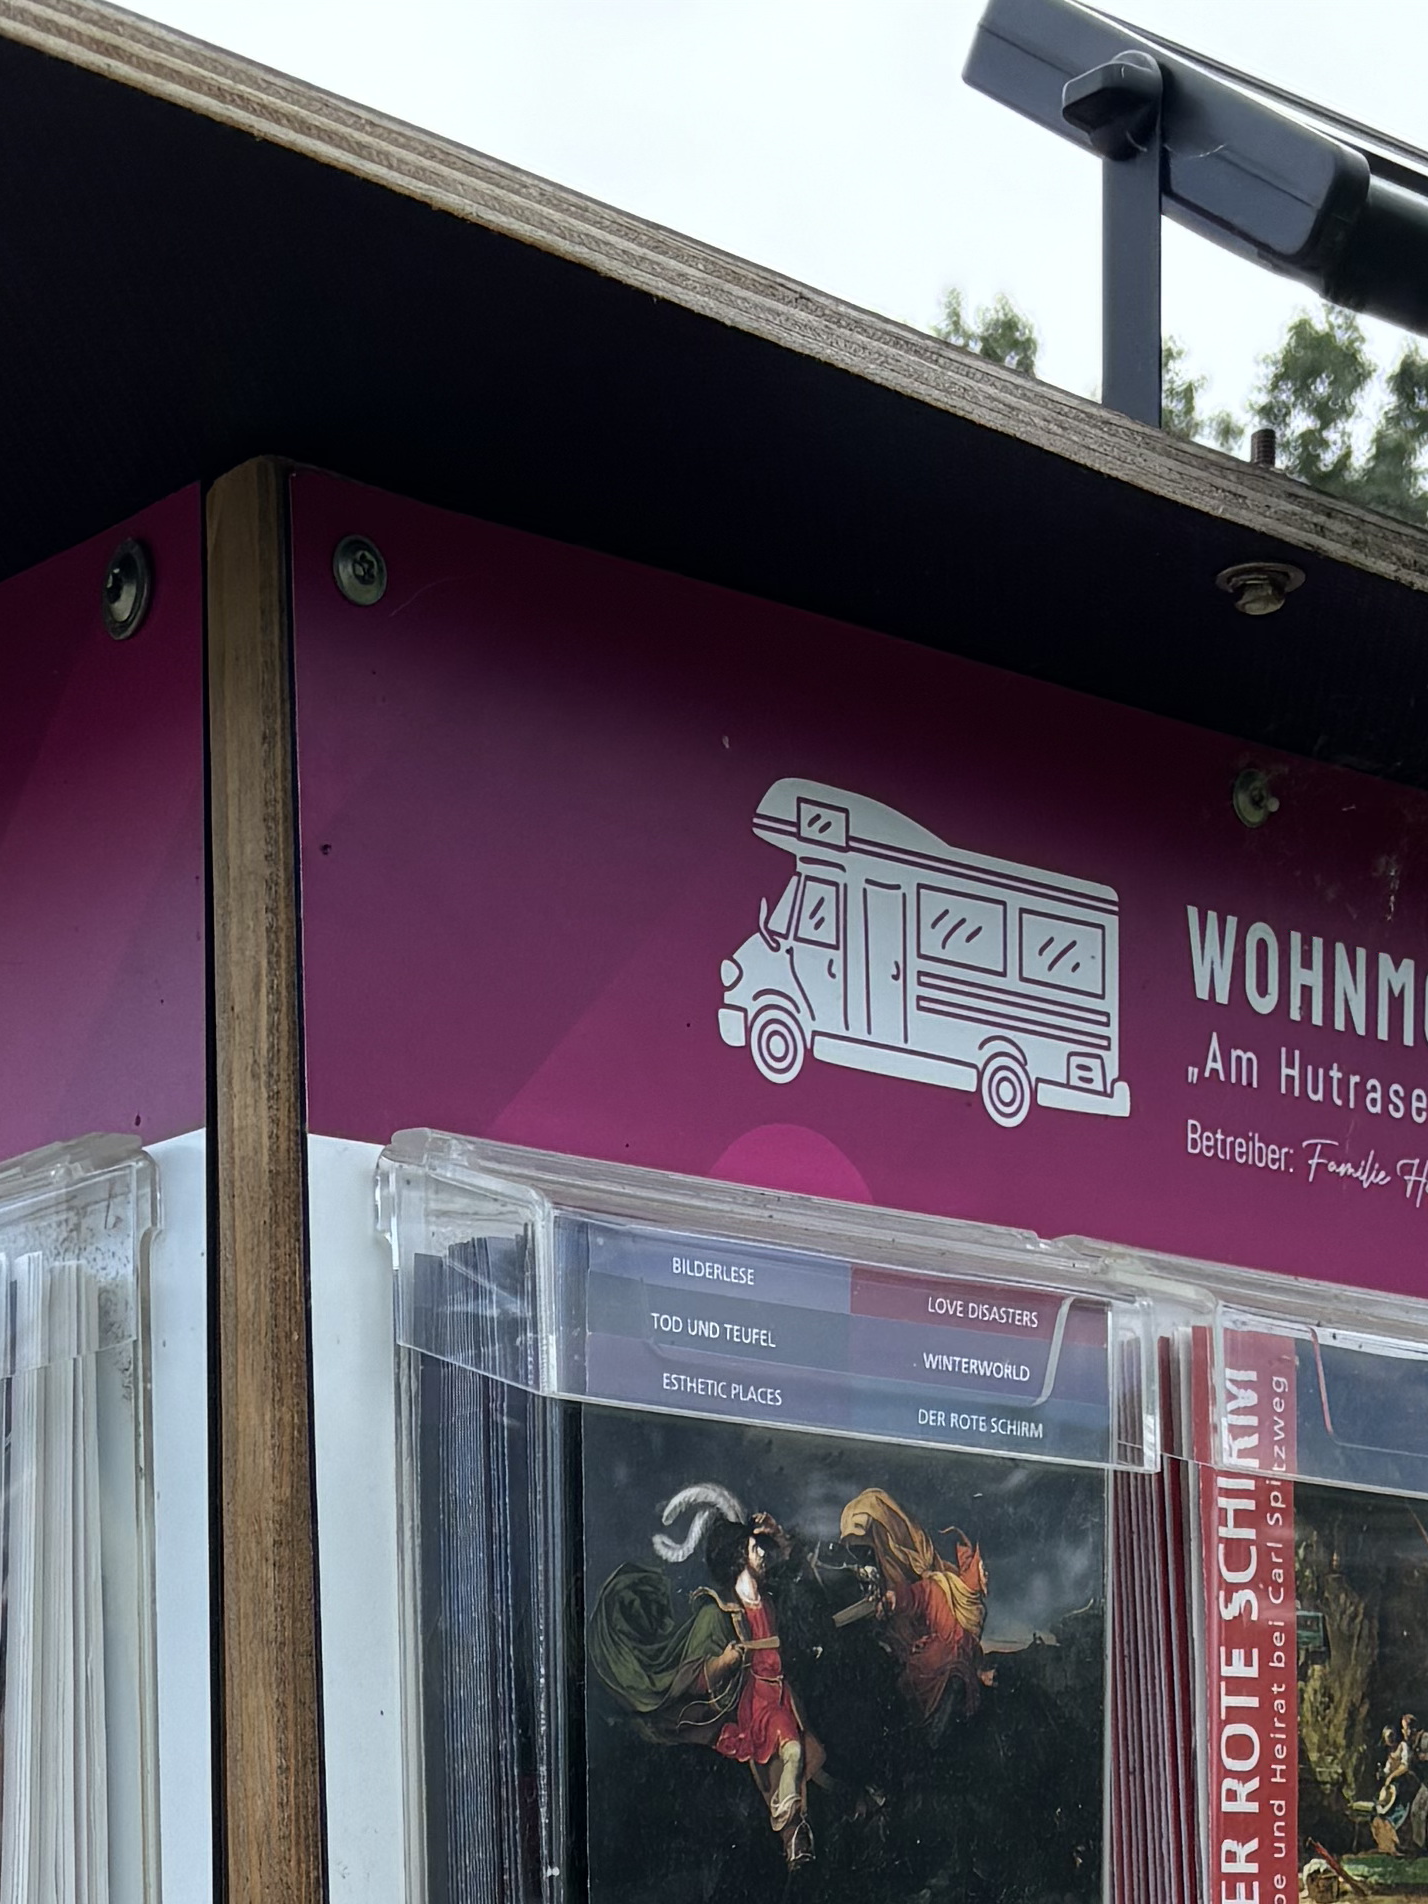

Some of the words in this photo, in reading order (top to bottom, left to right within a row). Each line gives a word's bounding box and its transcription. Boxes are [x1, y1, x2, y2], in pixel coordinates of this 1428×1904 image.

[1185, 1119, 1296, 1174] Betreiber:
[1301, 1136, 1392, 1192] Familie
[671, 1256, 756, 1286] BILDERLESE
[651, 1312, 683, 1333] TOD
[687, 1317, 720, 1339] UND
[724, 1321, 776, 1349] TEUFEL
[928, 1296, 965, 1319] LOVE
[968, 1300, 1039, 1328] DISASTERS
[662, 1373, 728, 1400] ESTHETIC
[731, 1380, 783, 1406] PLACES
[922, 1351, 1031, 1382] WINTERWORLD
[917, 1408, 946, 1427] DER
[949, 1412, 987, 1431] ROTE
[990, 1417, 1044, 1439] SCHIRM
[1266, 1375, 1289, 1526] Spitzweg
[1217, 1367, 1260, 1621] SCHIRM
[1268, 1543, 1284, 1604] Carl
[1269, 1622, 1285, 1668] bei
[1219, 1647, 1262, 1813] ROTE
[1270, 1682, 1287, 1784] Heirat
[1269, 1800, 1286, 1857] und
